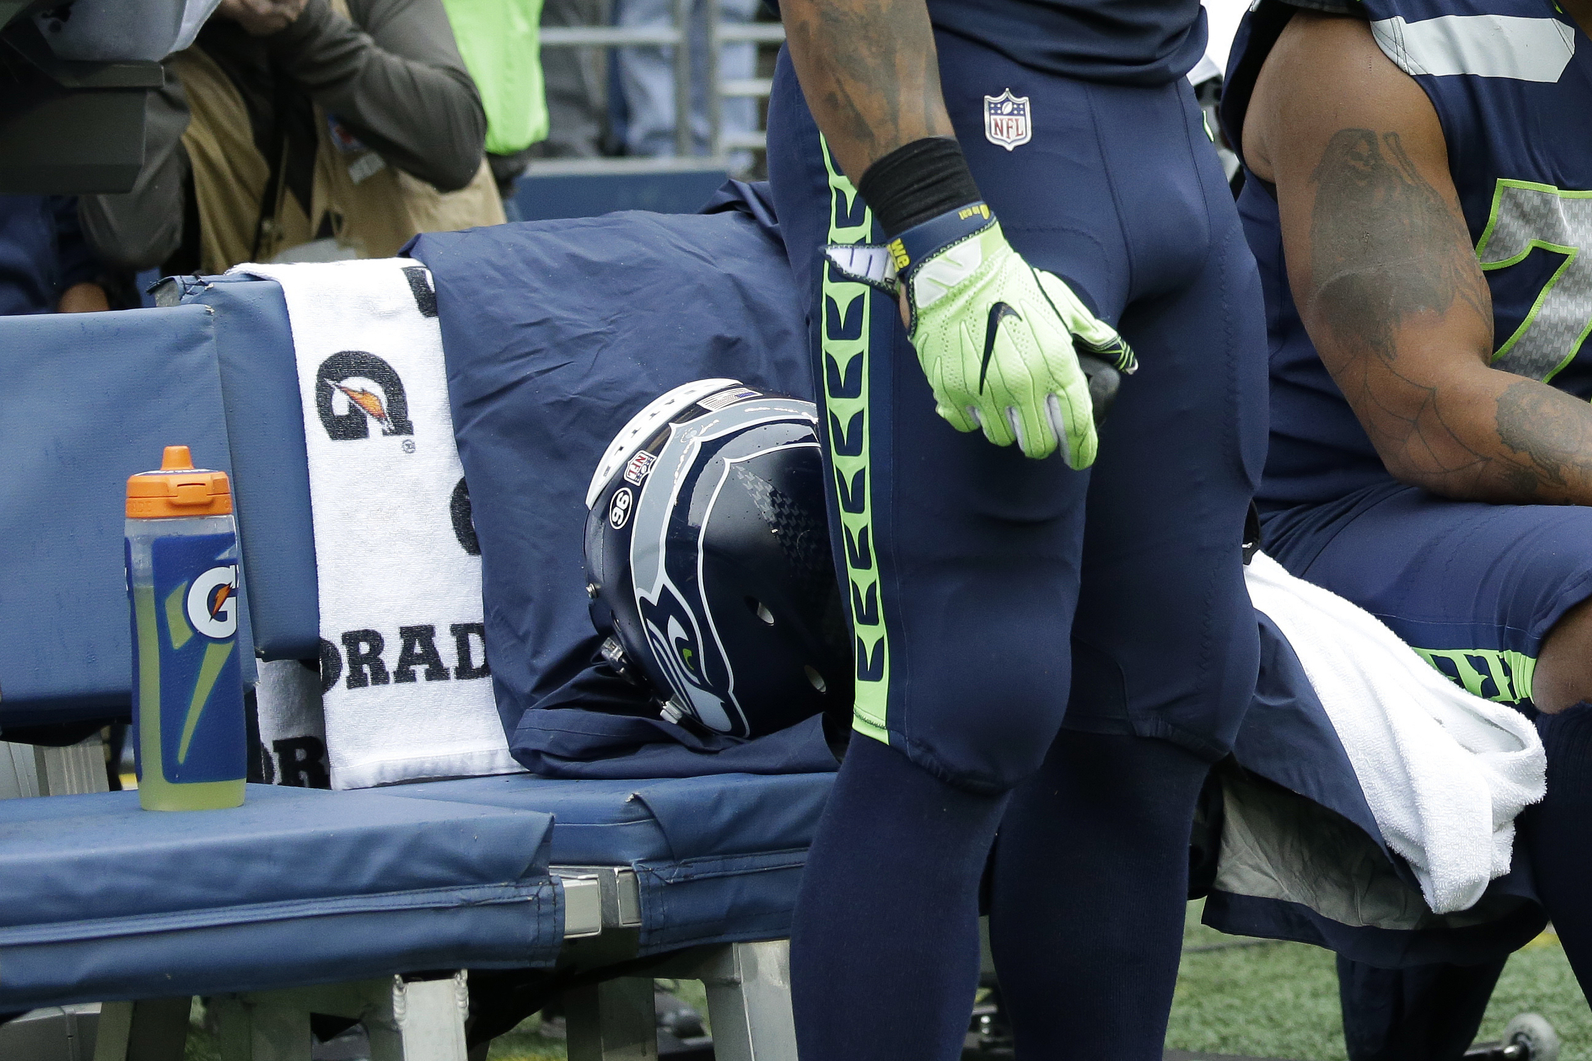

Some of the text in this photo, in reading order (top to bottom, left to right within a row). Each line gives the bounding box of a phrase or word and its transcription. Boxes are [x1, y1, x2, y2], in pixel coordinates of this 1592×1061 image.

[993, 118, 1024, 140] NFL
[316, 349, 415, 441] G
[626, 454, 647, 478] NFL
[187, 565, 238, 639] G
